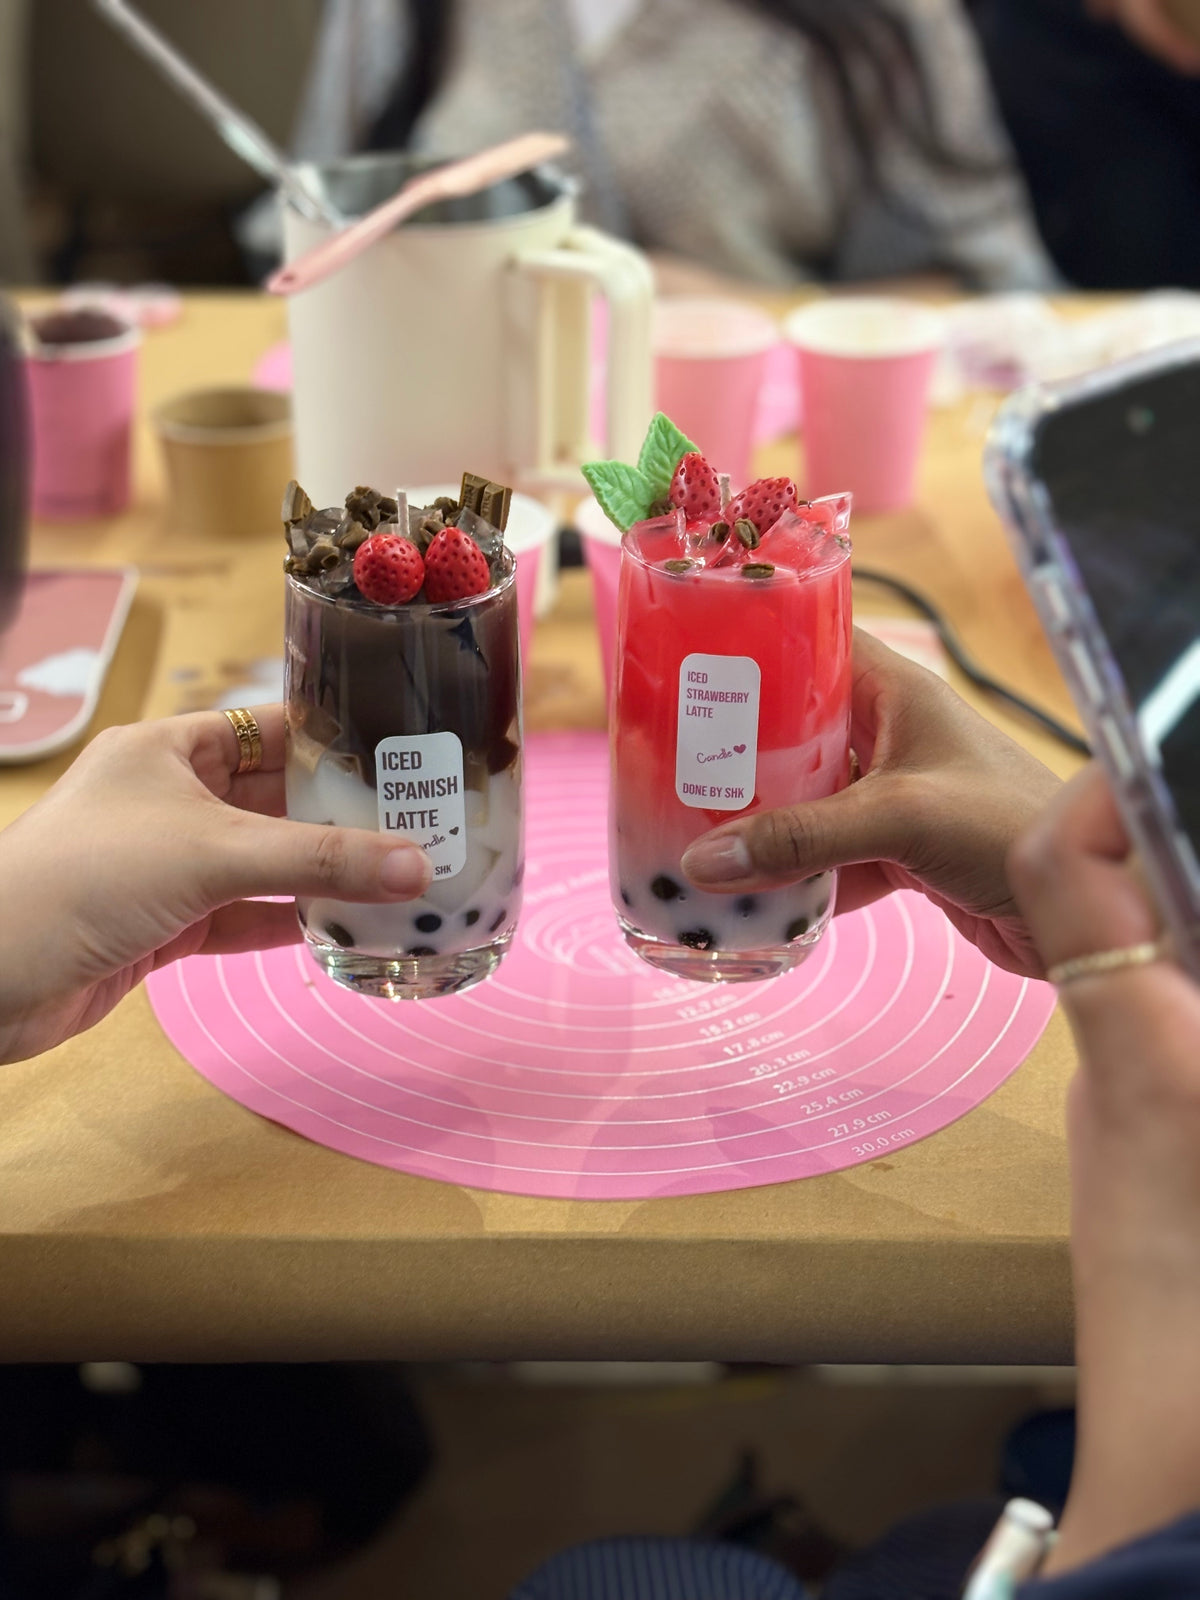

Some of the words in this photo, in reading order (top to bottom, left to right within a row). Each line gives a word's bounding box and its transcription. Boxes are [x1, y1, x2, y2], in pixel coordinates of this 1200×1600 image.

[687, 671, 708, 684] ICED
[686, 688, 749, 703] STRAWBERRY
[686, 705, 713, 718] LATTE
[382, 751, 422, 770] ICED
[696, 748, 733, 763] Candle
[384, 776, 458, 800] SPANISH
[683, 782, 707, 797] DONE
[710, 786, 722, 797] BY
[724, 787, 744, 798] SHK
[385, 809, 439, 830] LATTE
[419, 834, 446, 849] ndle
[435, 864, 452, 875] SHK
[749, 1057, 787, 1076] 20.3
[786, 1049, 811, 1062] cm
[773, 1075, 810, 1094] 22.9
[811, 1068, 837, 1080] cm
[800, 1095, 838, 1115] 25.4
[839, 1088, 864, 1101] cm
[827, 1118, 866, 1138] 27.9
[867, 1110, 892, 1124] cm
[851, 1137, 889, 1156] 30.0
[890, 1128, 915, 1142] cm
